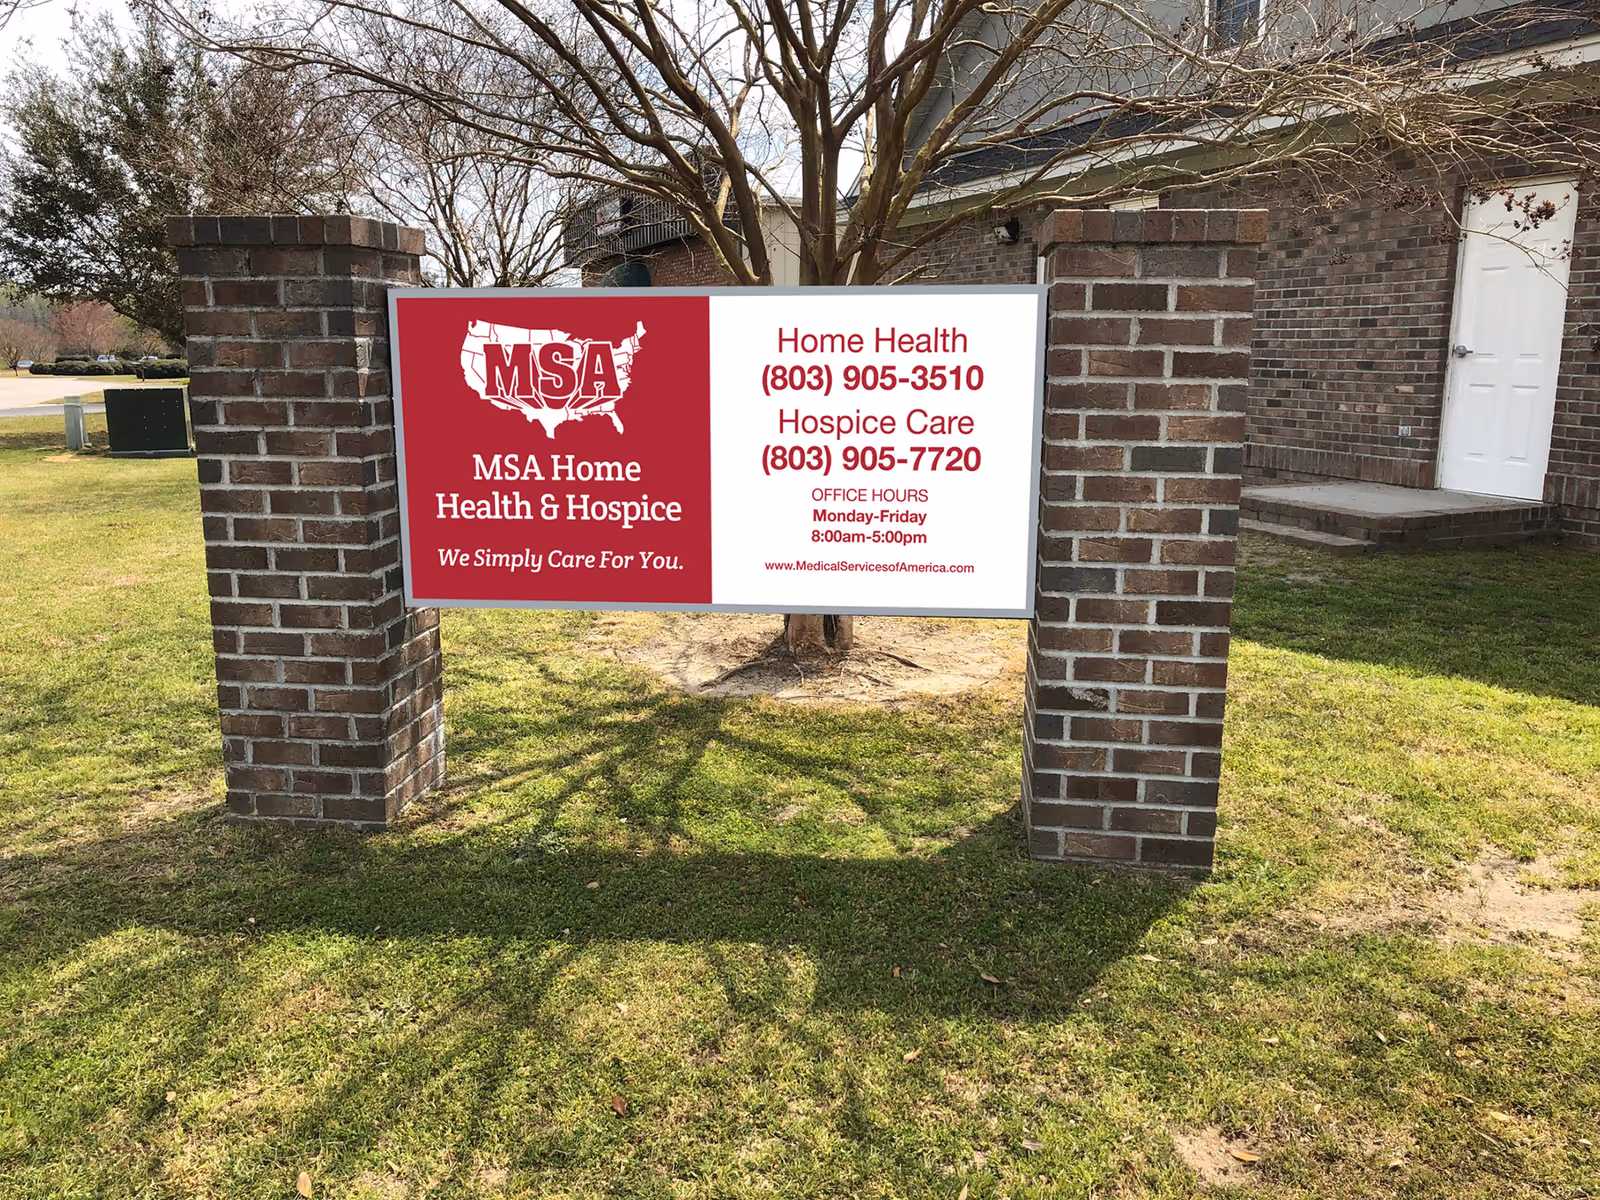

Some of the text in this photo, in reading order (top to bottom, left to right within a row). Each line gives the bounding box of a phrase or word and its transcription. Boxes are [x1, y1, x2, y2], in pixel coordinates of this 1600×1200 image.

[779, 327, 967, 353] Home Health
[482, 341, 623, 400] MSA
[762, 365, 983, 396] (803) 905-3510
[780, 409, 974, 440] Hospice Care
[473, 454, 641, 481] MSA Home
[762, 445, 981, 476] (803) 905-7720
[812, 488, 928, 502] OFFICE HOURS
[436, 491, 681, 528] Health & Hospice
[813, 509, 927, 525] Monday-Friday
[812, 530, 927, 546] 8:00am-5:00pm
[438, 549, 683, 572] We Simply Care For You.
[765, 561, 974, 573] www.MedicalServicesofAmerica.com
